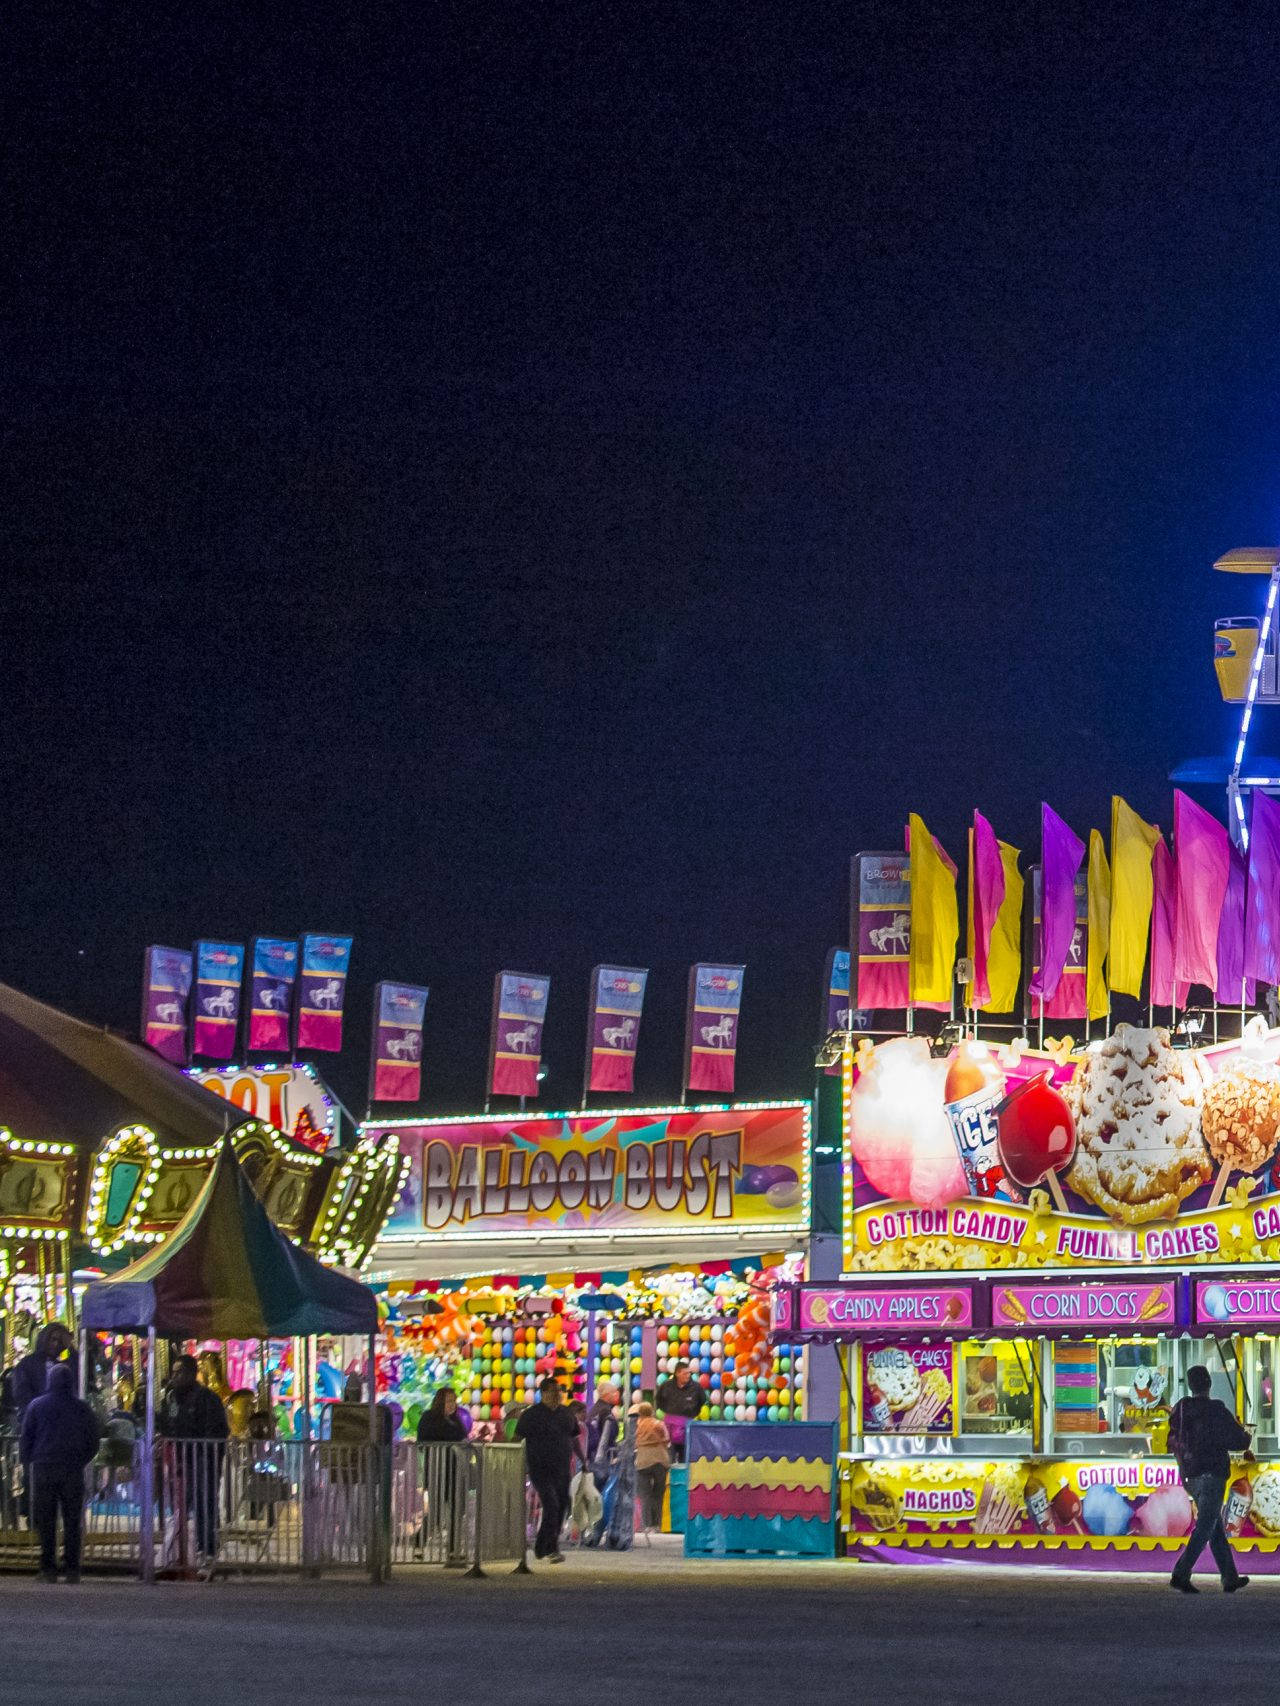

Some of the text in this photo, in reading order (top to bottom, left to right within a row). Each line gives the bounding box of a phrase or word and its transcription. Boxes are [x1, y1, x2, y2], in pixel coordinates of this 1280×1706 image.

[424, 1128, 744, 1229] BALLOON BUST
[867, 1208, 1028, 1246] COTTON CANDY
[1057, 1223, 1219, 1260] FUNNEL CAKES
[832, 1296, 940, 1321] CANDY APPLES
[1030, 1292, 1138, 1318] CORN DOGS
[911, 1349, 950, 1368] CAKES
[1078, 1465, 1139, 1489] COTTON
[904, 1488, 977, 1512] NACHOS
